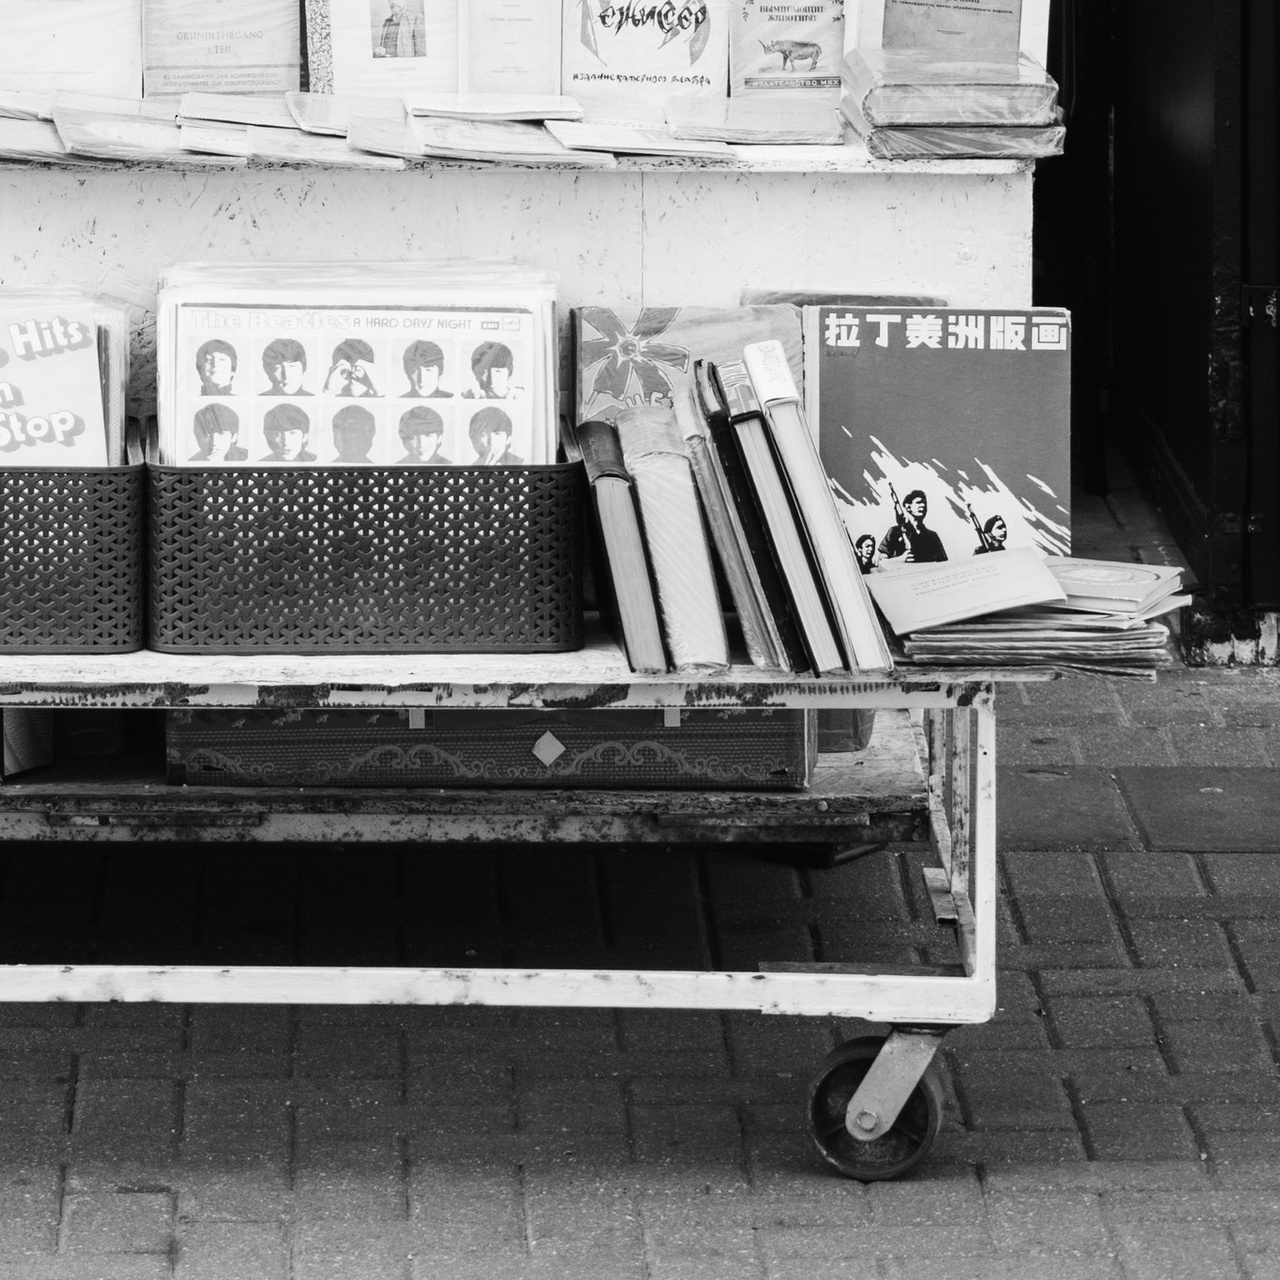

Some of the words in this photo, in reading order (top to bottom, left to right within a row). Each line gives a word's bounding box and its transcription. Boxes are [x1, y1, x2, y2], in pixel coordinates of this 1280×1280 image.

[176, 31, 264, 40] GRUNDLEHRGANG
[214, 46, 233, 55] TEIL
[191, 310, 240, 329] The
[249, 310, 350, 330] Beatles
[353, 317, 360, 328] A
[366, 317, 398, 328] HARD
[403, 317, 434, 329] DAY'S
[438, 319, 472, 330] NIGHT
[8, 316, 91, 361] Hits
[824, 312, 1067, 351] 拉丁美洲版画
